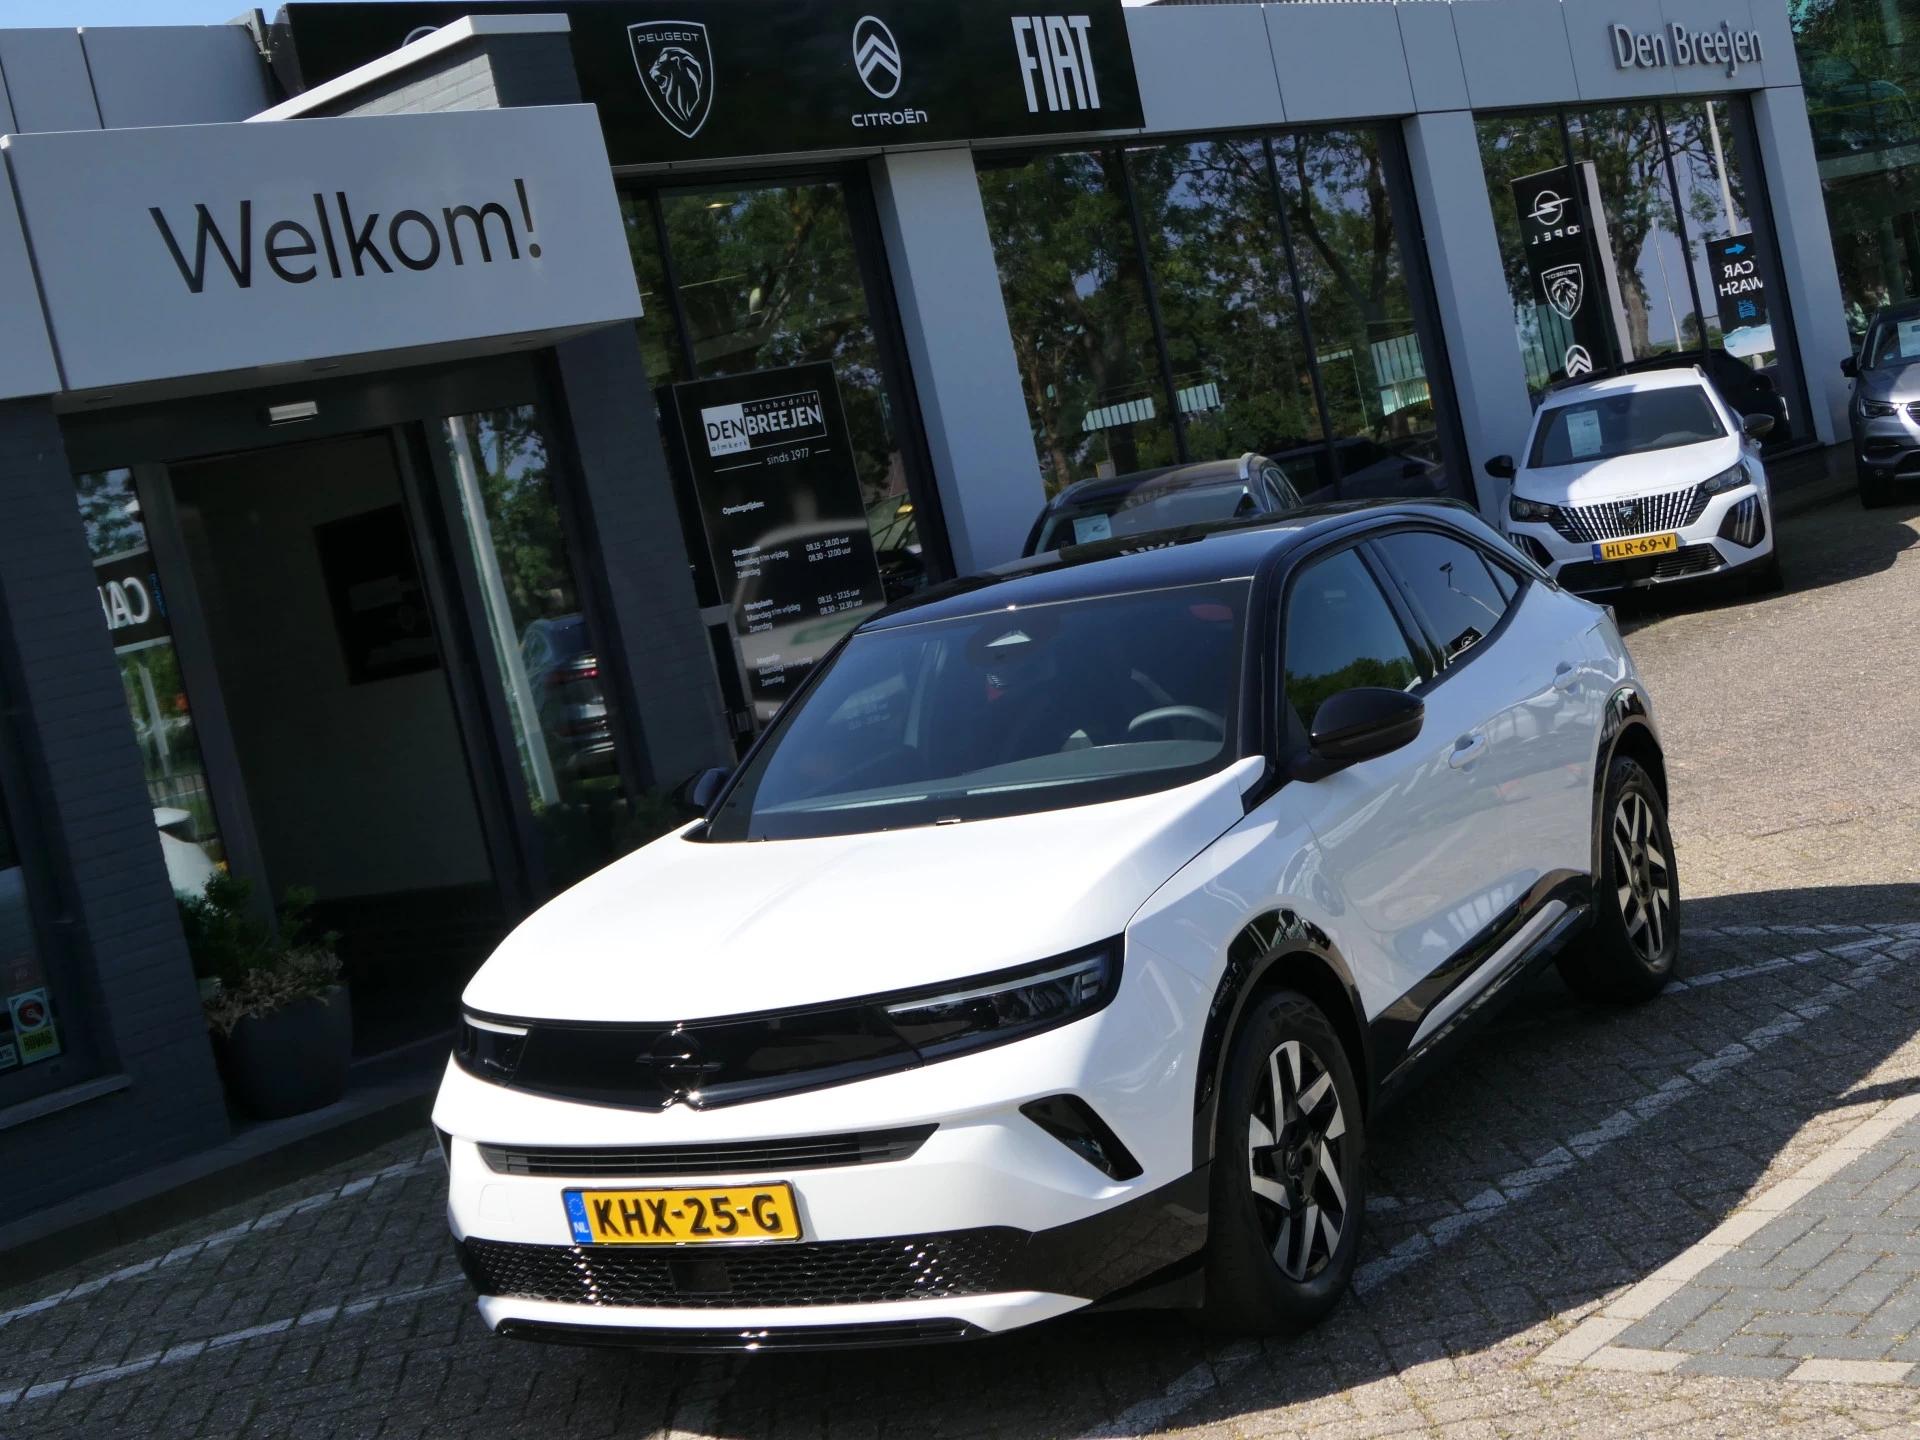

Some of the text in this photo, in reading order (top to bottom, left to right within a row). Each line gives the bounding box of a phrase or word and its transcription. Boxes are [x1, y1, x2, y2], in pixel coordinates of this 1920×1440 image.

[637, 32, 700, 44] PEUGEOT
[1608, 19, 1764, 78] Den Breejen
[1011, 15, 1100, 112] FIAT
[148, 178, 541, 294] Welkom!
[744, 394, 817, 413] autobedrijf
[707, 404, 822, 441] DEN BREEJEN
[766, 448, 809, 465] sinds 1977
[824, 537, 840, 548] 18.00
[839, 536, 849, 544] uur
[1606, 536, 1671, 558] HLR-69-V
[770, 550, 789, 560] vrijdag
[808, 552, 823, 562] 08.30
[827, 548, 841, 558] 17.00
[841, 546, 851, 554] uur
[817, 594, 832, 605] 08.15
[851, 589, 860, 597] uur
[746, 611, 772, 622] Maandag
[782, 603, 801, 614] vrijdag
[820, 605, 835, 616] 08.30
[838, 600, 853, 610] 12.30
[853, 599, 863, 607] uur
[749, 622, 773, 633] Zaterdag
[761, 675, 785, 687] Zaterdag
[593, 1193, 781, 1238] KHX-25-G
[574, 1221, 589, 1233] NL
